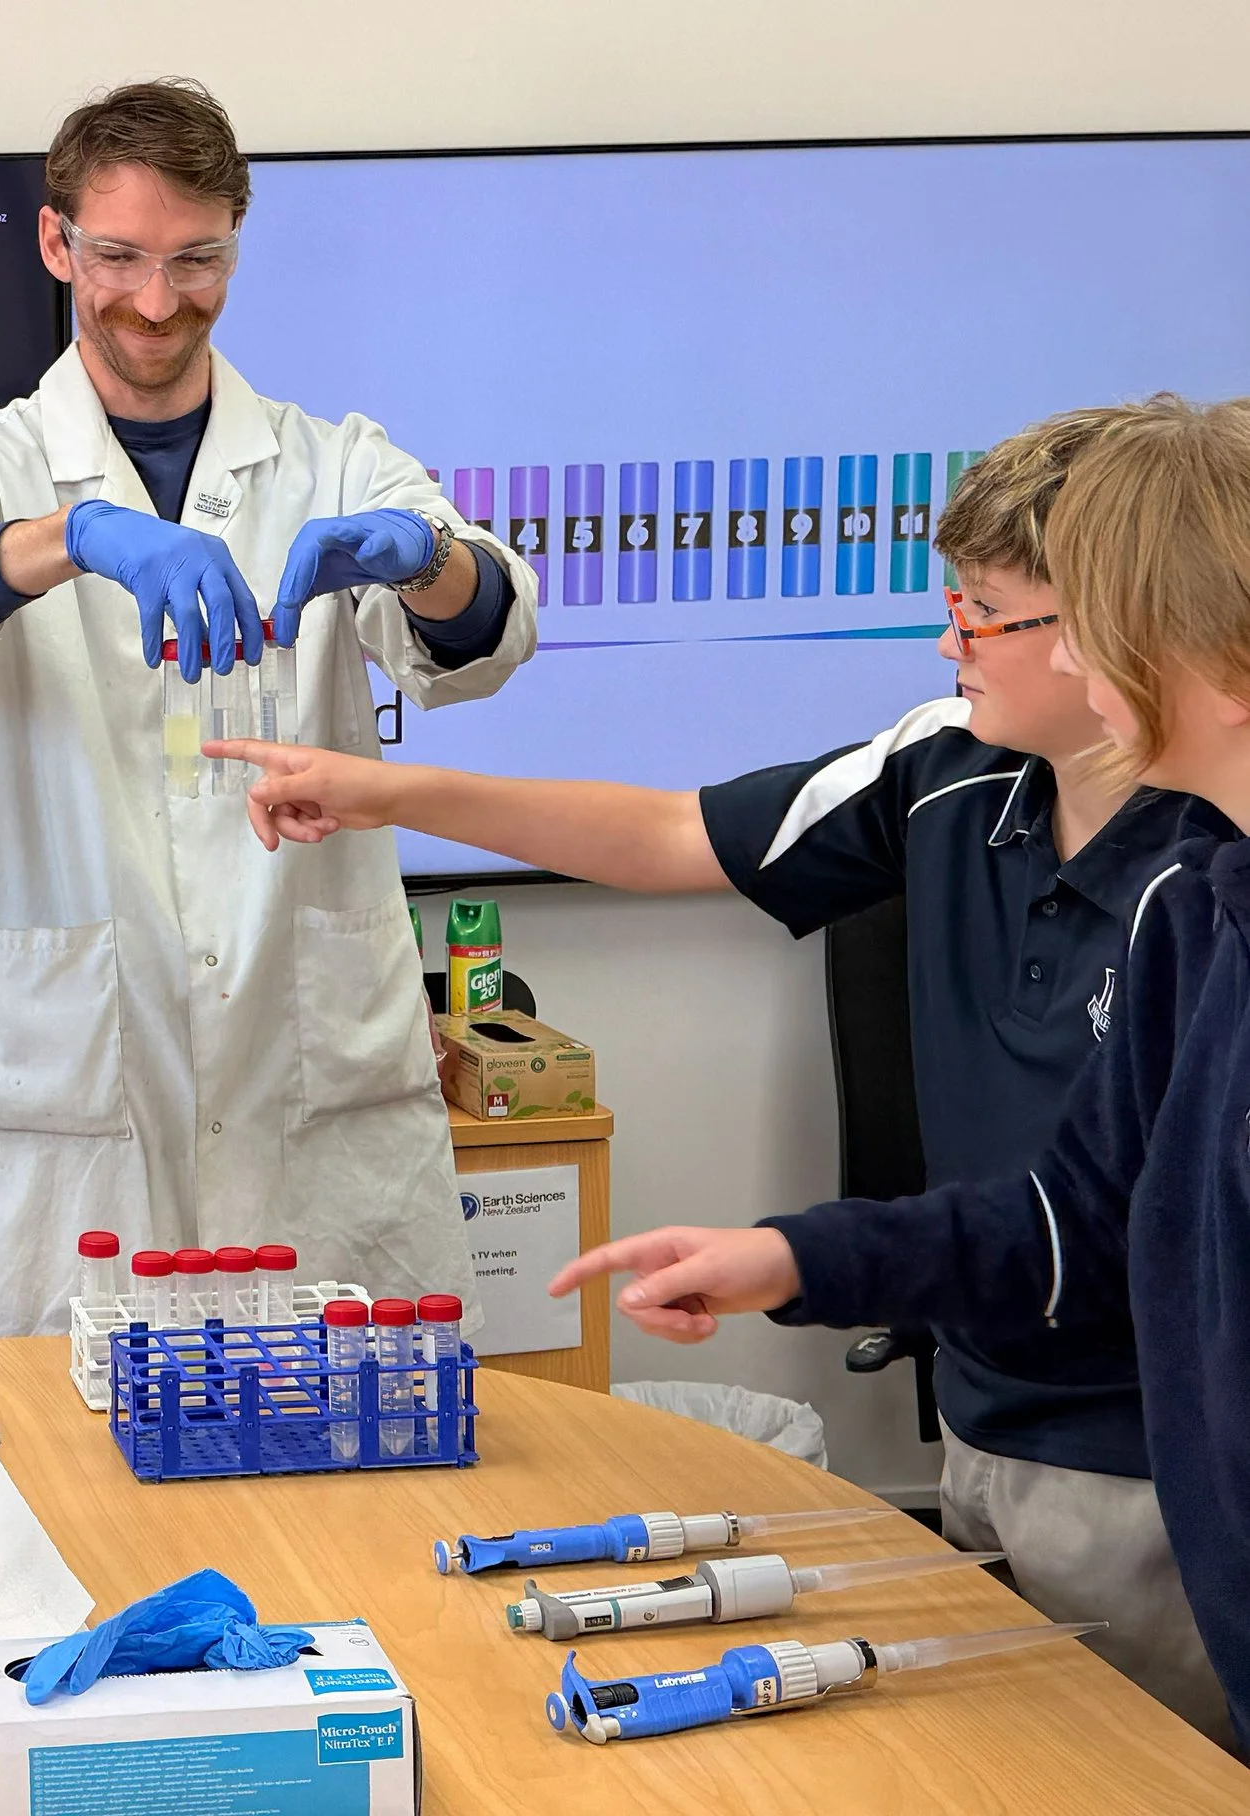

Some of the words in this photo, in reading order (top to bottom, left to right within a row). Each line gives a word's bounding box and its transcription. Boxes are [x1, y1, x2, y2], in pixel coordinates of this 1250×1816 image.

[516, 522, 540, 550] 4
[571, 520, 595, 549] 5
[626, 517, 650, 548] 6
[680, 516, 705, 546] 7
[735, 513, 759, 544] 8
[790, 512, 814, 543] 9
[842, 511, 872, 538] 10
[899, 510, 924, 536] 11
[480, 985, 496, 1001] 20
[486, 1058, 526, 1072] gloveen
[493, 1095, 504, 1106] M
[482, 1195, 514, 1208] Earth
[515, 1191, 566, 1205] Sciences
[482, 1208, 504, 1217] New
[505, 1204, 541, 1216] Zealand
[477, 1250, 490, 1260] TV
[491, 1249, 518, 1259] when
[475, 1266, 518, 1277] meeting.
[763, 1679, 771, 1690] 20
[321, 1722, 397, 1738] Micro-Touch
[324, 1738, 371, 1750] NitraTex
